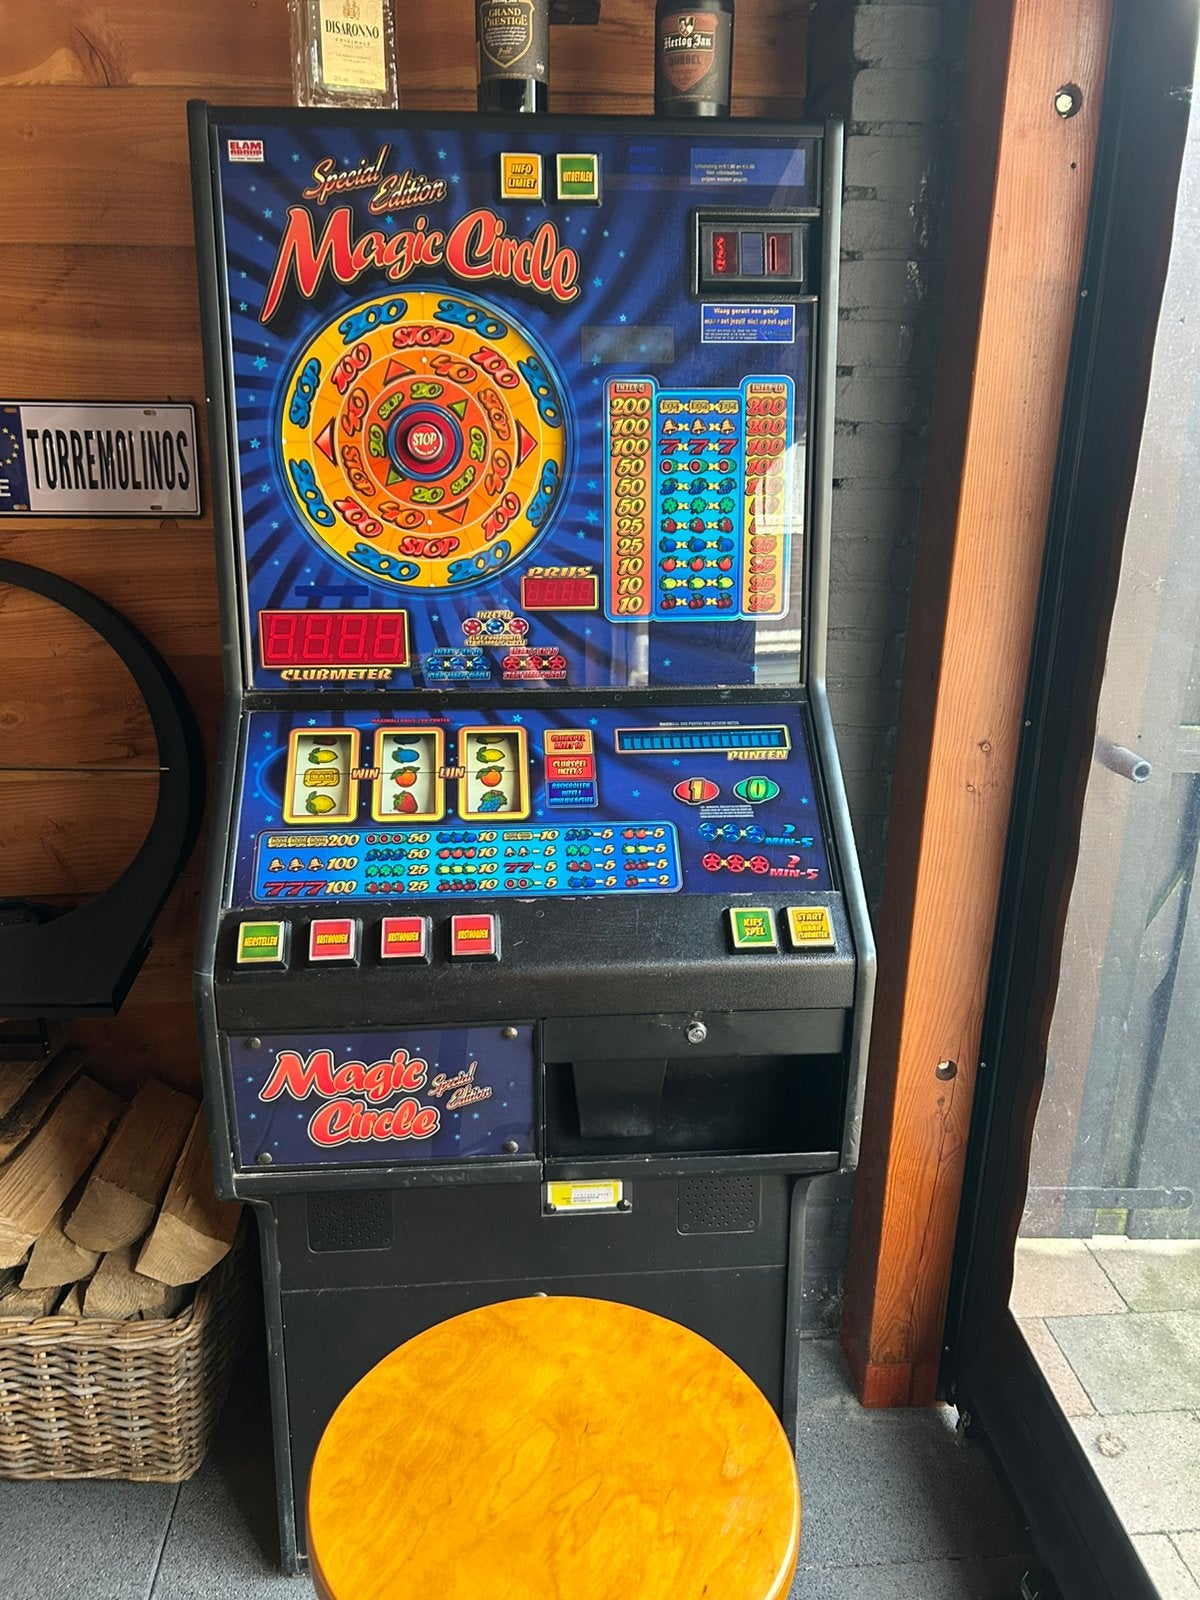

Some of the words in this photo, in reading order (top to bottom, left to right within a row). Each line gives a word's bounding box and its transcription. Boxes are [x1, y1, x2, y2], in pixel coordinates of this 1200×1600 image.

[484, 15, 528, 28] PRESTIGE
[489, 7, 521, 17] GRAND
[325, 19, 380, 39] DISARONNO
[663, 36, 693, 50] Hertog
[693, 34, 711, 48] Jan
[230, 142, 261, 150] ELAM
[303, 143, 390, 205] Special
[512, 163, 533, 174] INFO
[563, 171, 593, 182] UITBETALEN
[368, 169, 447, 216] Edition
[508, 177, 537, 189] LIMIET
[259, 206, 445, 322] Magic
[446, 209, 581, 301] Circle
[433, 299, 508, 340] 200
[713, 307, 730, 315] Waag
[338, 298, 408, 345] 200
[392, 325, 454, 348] STOP
[331, 343, 371, 395] 100
[430, 355, 477, 384] 40
[470, 346, 520, 388] 100
[410, 381, 444, 400] 20
[517, 356, 563, 429] 200
[341, 387, 369, 437] 40
[378, 392, 404, 421] STOP
[478, 387, 511, 440] STOP
[610, 396, 650, 416] 200
[746, 396, 786, 416] 200
[611, 417, 650, 437] 100
[746, 416, 786, 437] 200
[368, 424, 386, 457] 20
[413, 432, 437, 446] STOP
[468, 427, 487, 462] 20
[611, 437, 650, 457] 100
[745, 436, 785, 456] 100
[26, 428, 190, 490] TORREMOLINOS
[615, 457, 646, 477] 50
[341, 444, 376, 497] STOP
[450, 465, 475, 496] STOP
[485, 449, 512, 496] 40
[288, 458, 336, 527] 200
[410, 486, 445, 504] 20
[615, 477, 646, 497] 50
[333, 496, 384, 538] 100
[378, 501, 425, 530] 40
[481, 492, 520, 541] 100
[615, 497, 646, 517] 50
[616, 517, 645, 537] 25
[398, 536, 459, 558] STOP
[616, 537, 645, 557] 25
[749, 535, 777, 555] 25
[347, 542, 421, 581] 200
[447, 540, 511, 583] 200
[616, 556, 645, 576] 10
[749, 554, 777, 574] 25
[616, 575, 645, 595] 10
[748, 573, 776, 593] 25
[616, 595, 645, 615] 10
[748, 593, 776, 612] 25
[280, 668, 393, 681] CLUBMETER
[727, 750, 788, 761] PUNTEN
[352, 768, 380, 780] WIN
[439, 767, 465, 779] LIJN
[557, 767, 577, 775] INZET
[327, 834, 359, 848] 200
[407, 833, 431, 844] 50
[476, 831, 498, 842] 10
[407, 848, 431, 859] 50
[477, 846, 498, 858] 10
[326, 857, 359, 871] 100
[407, 864, 430, 876] 25
[477, 863, 499, 874] 10
[325, 881, 358, 894] 100
[407, 881, 430, 892] 25
[477, 878, 499, 890] 10
[743, 918, 763, 927] KIES
[797, 913, 824, 922] START
[244, 935, 278, 946] HERSTELLEN
[745, 927, 765, 936] SPEL
[259, 1048, 428, 1103] Magic
[428, 1061, 478, 1097] Special
[446, 1085, 492, 1110] Edition
[308, 1097, 440, 1147] Circle
